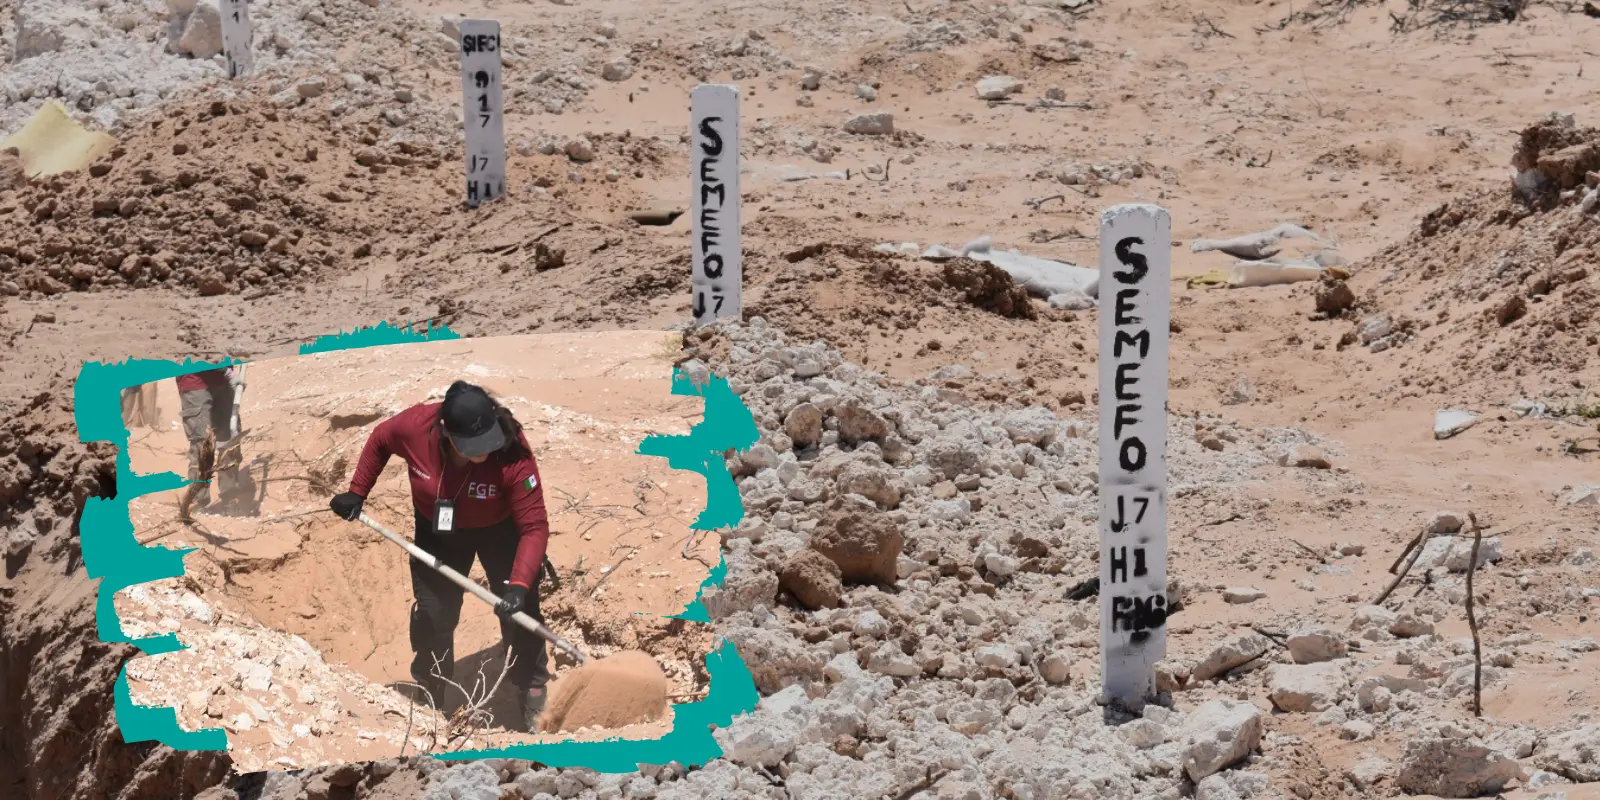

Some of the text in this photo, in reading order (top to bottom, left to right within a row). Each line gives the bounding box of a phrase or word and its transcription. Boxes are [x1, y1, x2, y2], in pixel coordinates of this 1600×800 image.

[699, 117, 725, 280] SEMEFO
[1112, 236, 1150, 473] SEMEFO
[468, 482, 497, 497] FGE
